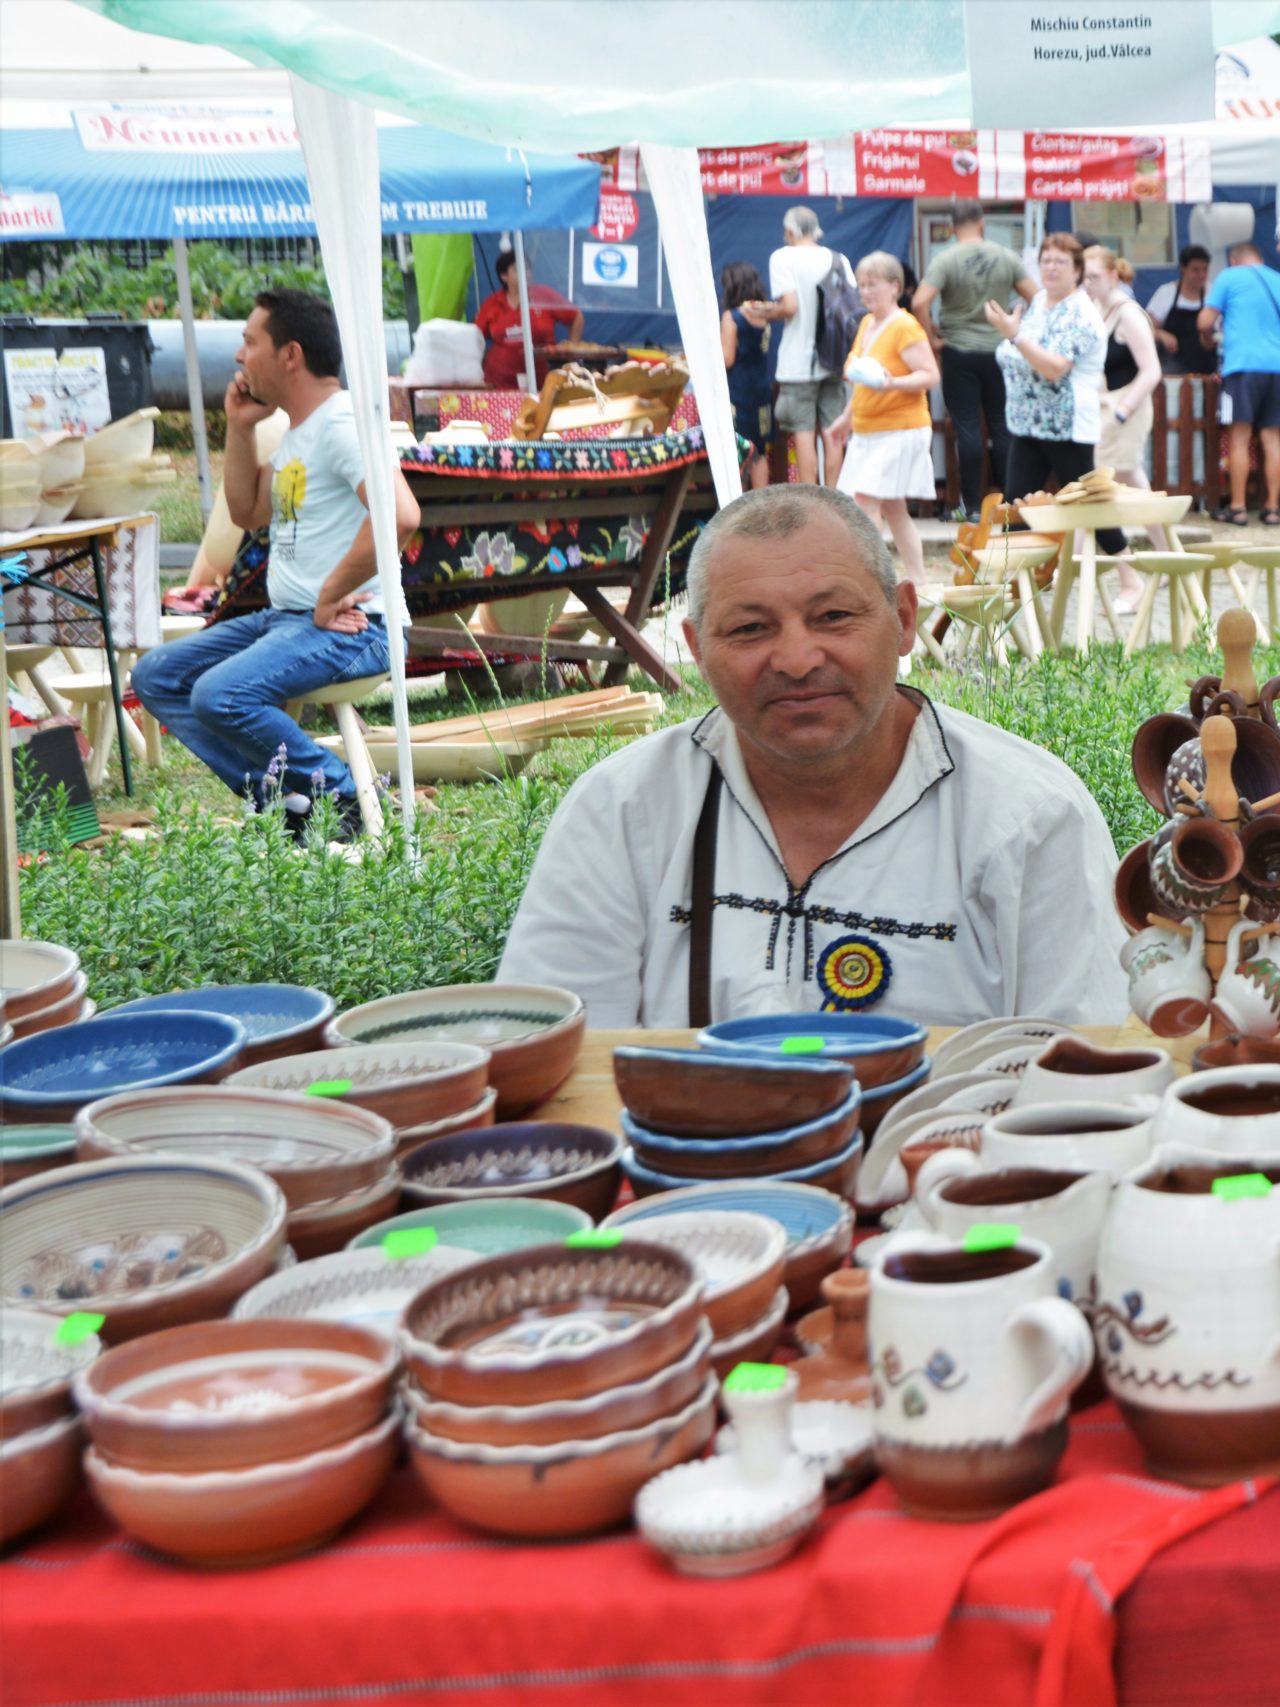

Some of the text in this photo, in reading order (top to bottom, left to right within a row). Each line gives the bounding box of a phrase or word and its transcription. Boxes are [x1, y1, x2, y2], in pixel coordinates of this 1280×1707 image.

[1030, 14, 1152, 31] Mischiu Constantin
[1033, 45, 1082, 61] Horezu,
[903, 129, 922, 147] de
[924, 130, 947, 152] pui
[740, 169, 763, 193] pui
[173, 202, 259, 226] PENTRU
[403, 200, 488, 221] TREBUIE
